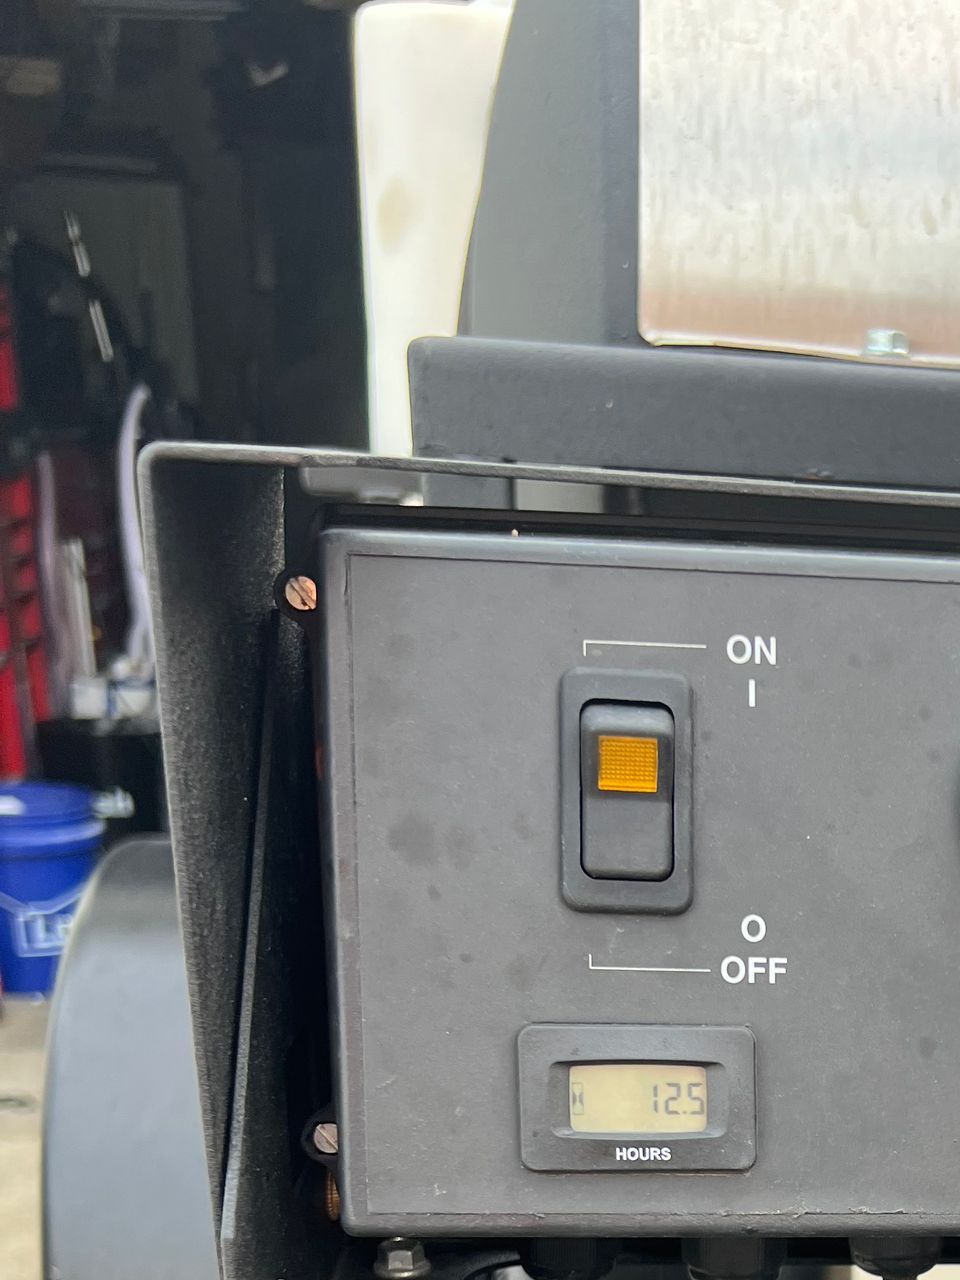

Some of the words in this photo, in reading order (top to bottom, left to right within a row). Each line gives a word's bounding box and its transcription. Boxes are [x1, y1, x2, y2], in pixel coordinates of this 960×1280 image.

[726, 634, 777, 665] ON
[720, 955, 788, 984] OFF
[615, 1147, 672, 1161] HOURS
